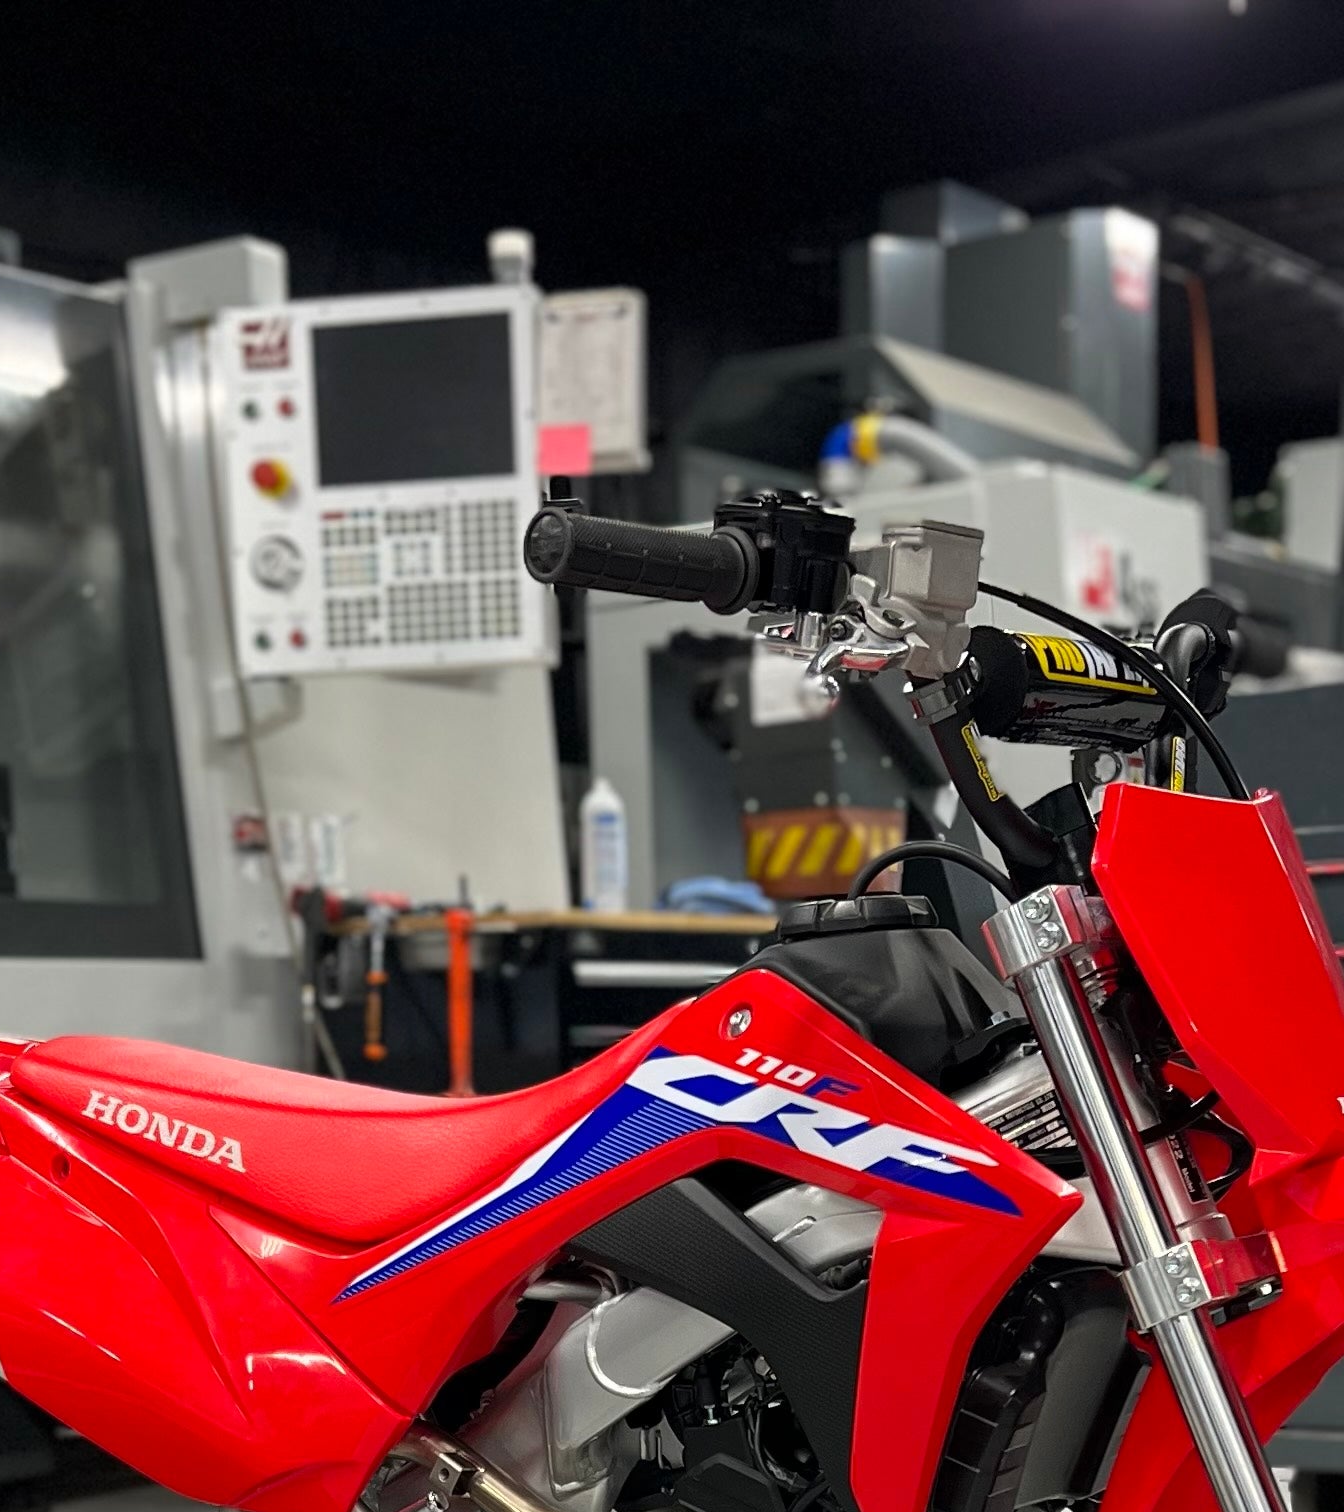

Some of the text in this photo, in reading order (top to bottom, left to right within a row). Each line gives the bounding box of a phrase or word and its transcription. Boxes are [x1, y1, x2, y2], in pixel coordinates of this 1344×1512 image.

[624, 1054, 1000, 1174] CRF
[735, 1047, 863, 1099] 110F
[81, 1089, 247, 1174] HONDA
